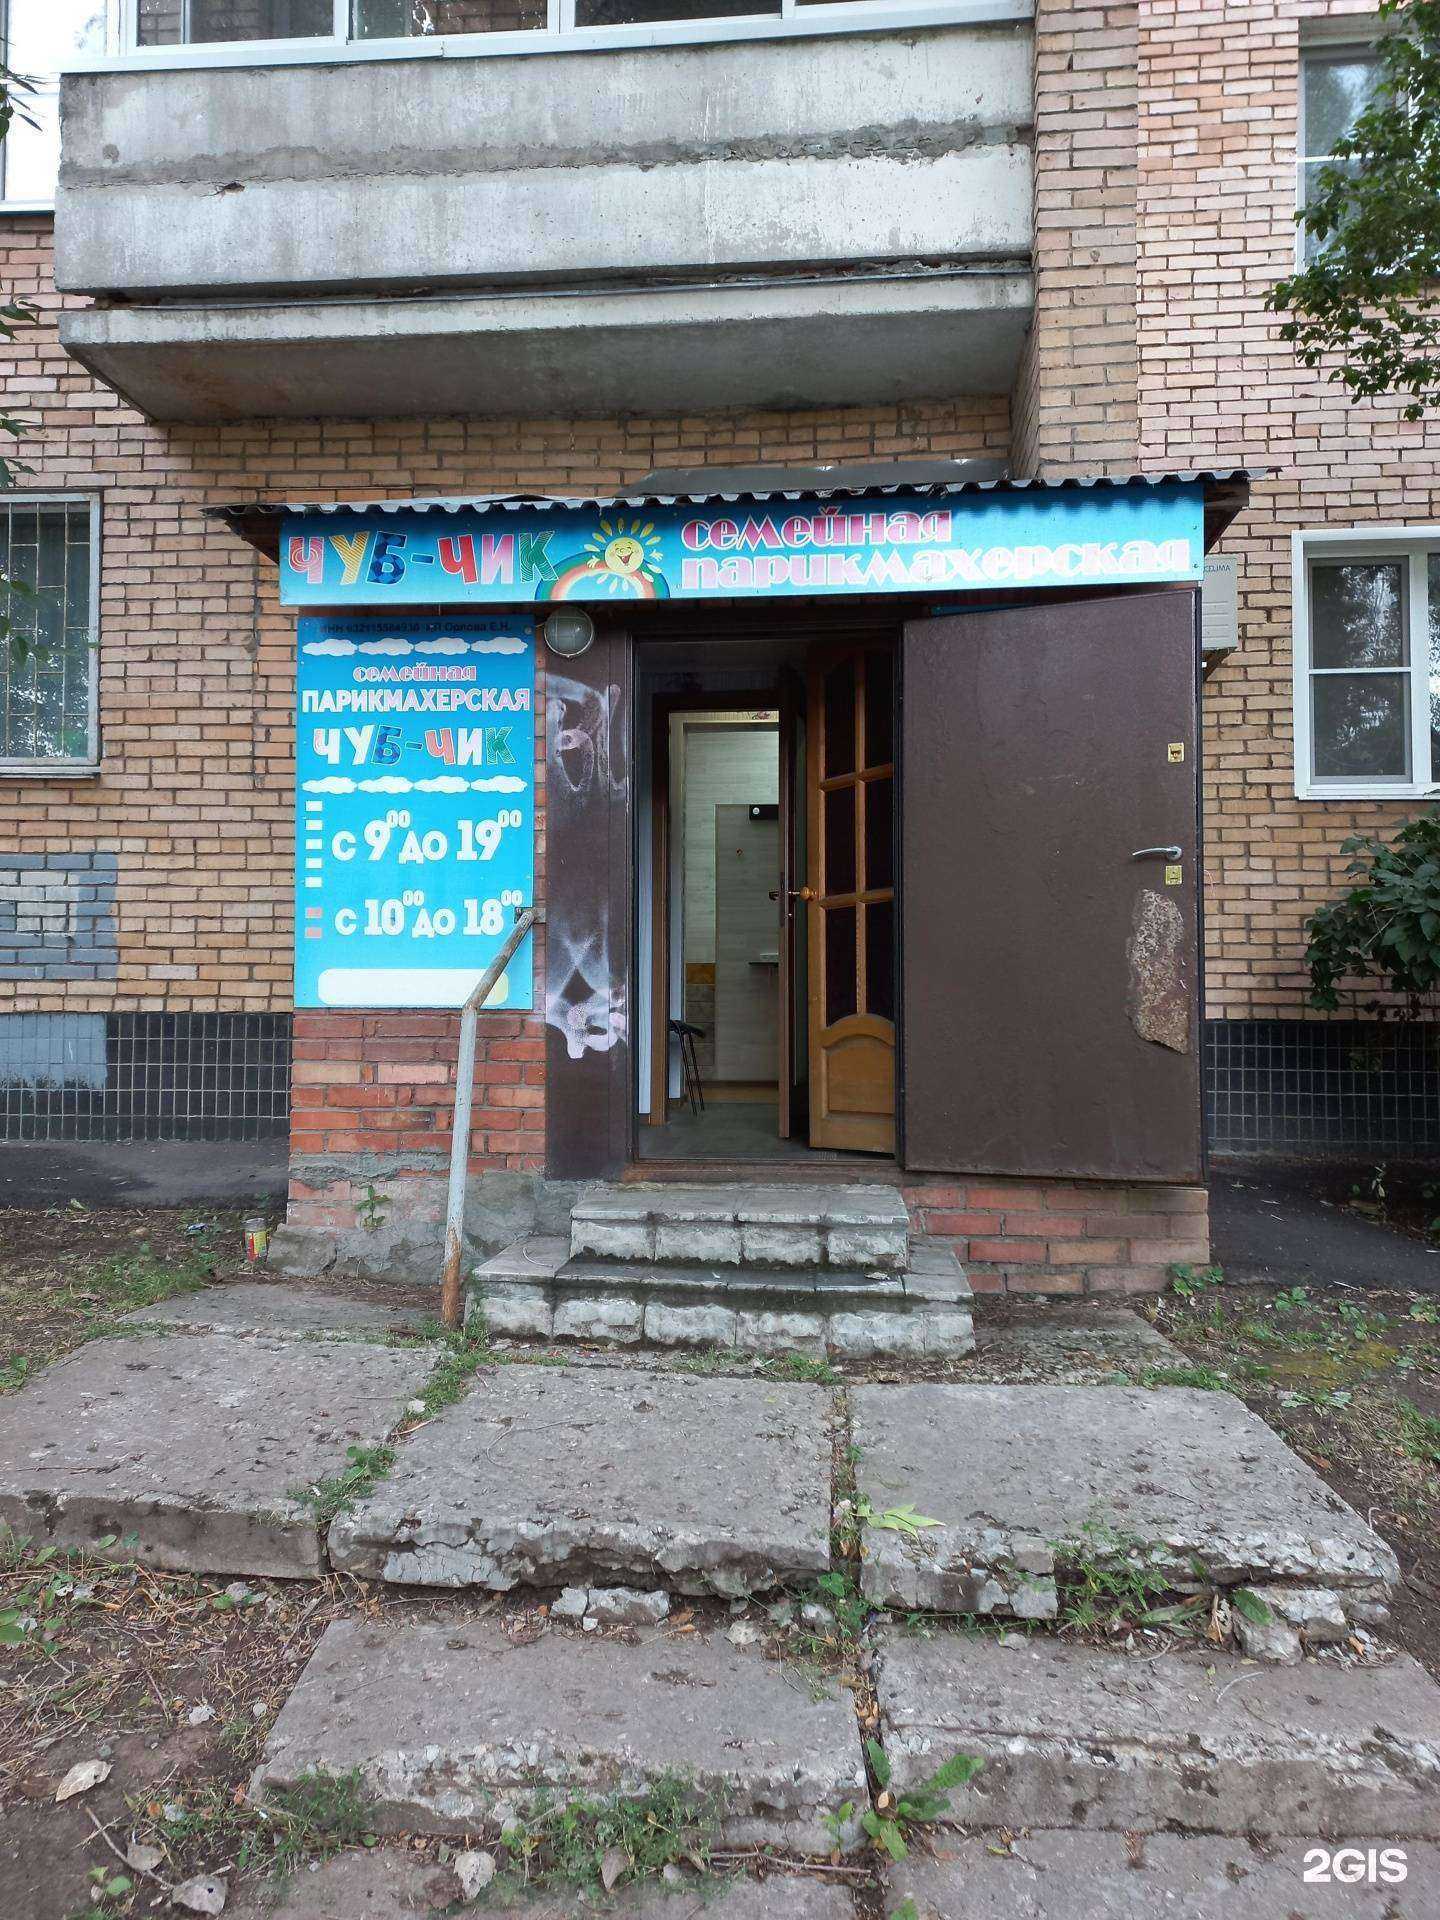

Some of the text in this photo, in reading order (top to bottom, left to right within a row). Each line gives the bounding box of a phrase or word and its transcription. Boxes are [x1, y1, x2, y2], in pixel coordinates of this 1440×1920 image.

[288, 530, 559, 586] ЧУБ-ЧИК
[681, 538, 1190, 590] парикмахерская
[302, 688, 530, 713] ПАРИКМАХЕРСКАЯ
[313, 724, 517, 766] ЧУБ-ЧИК
